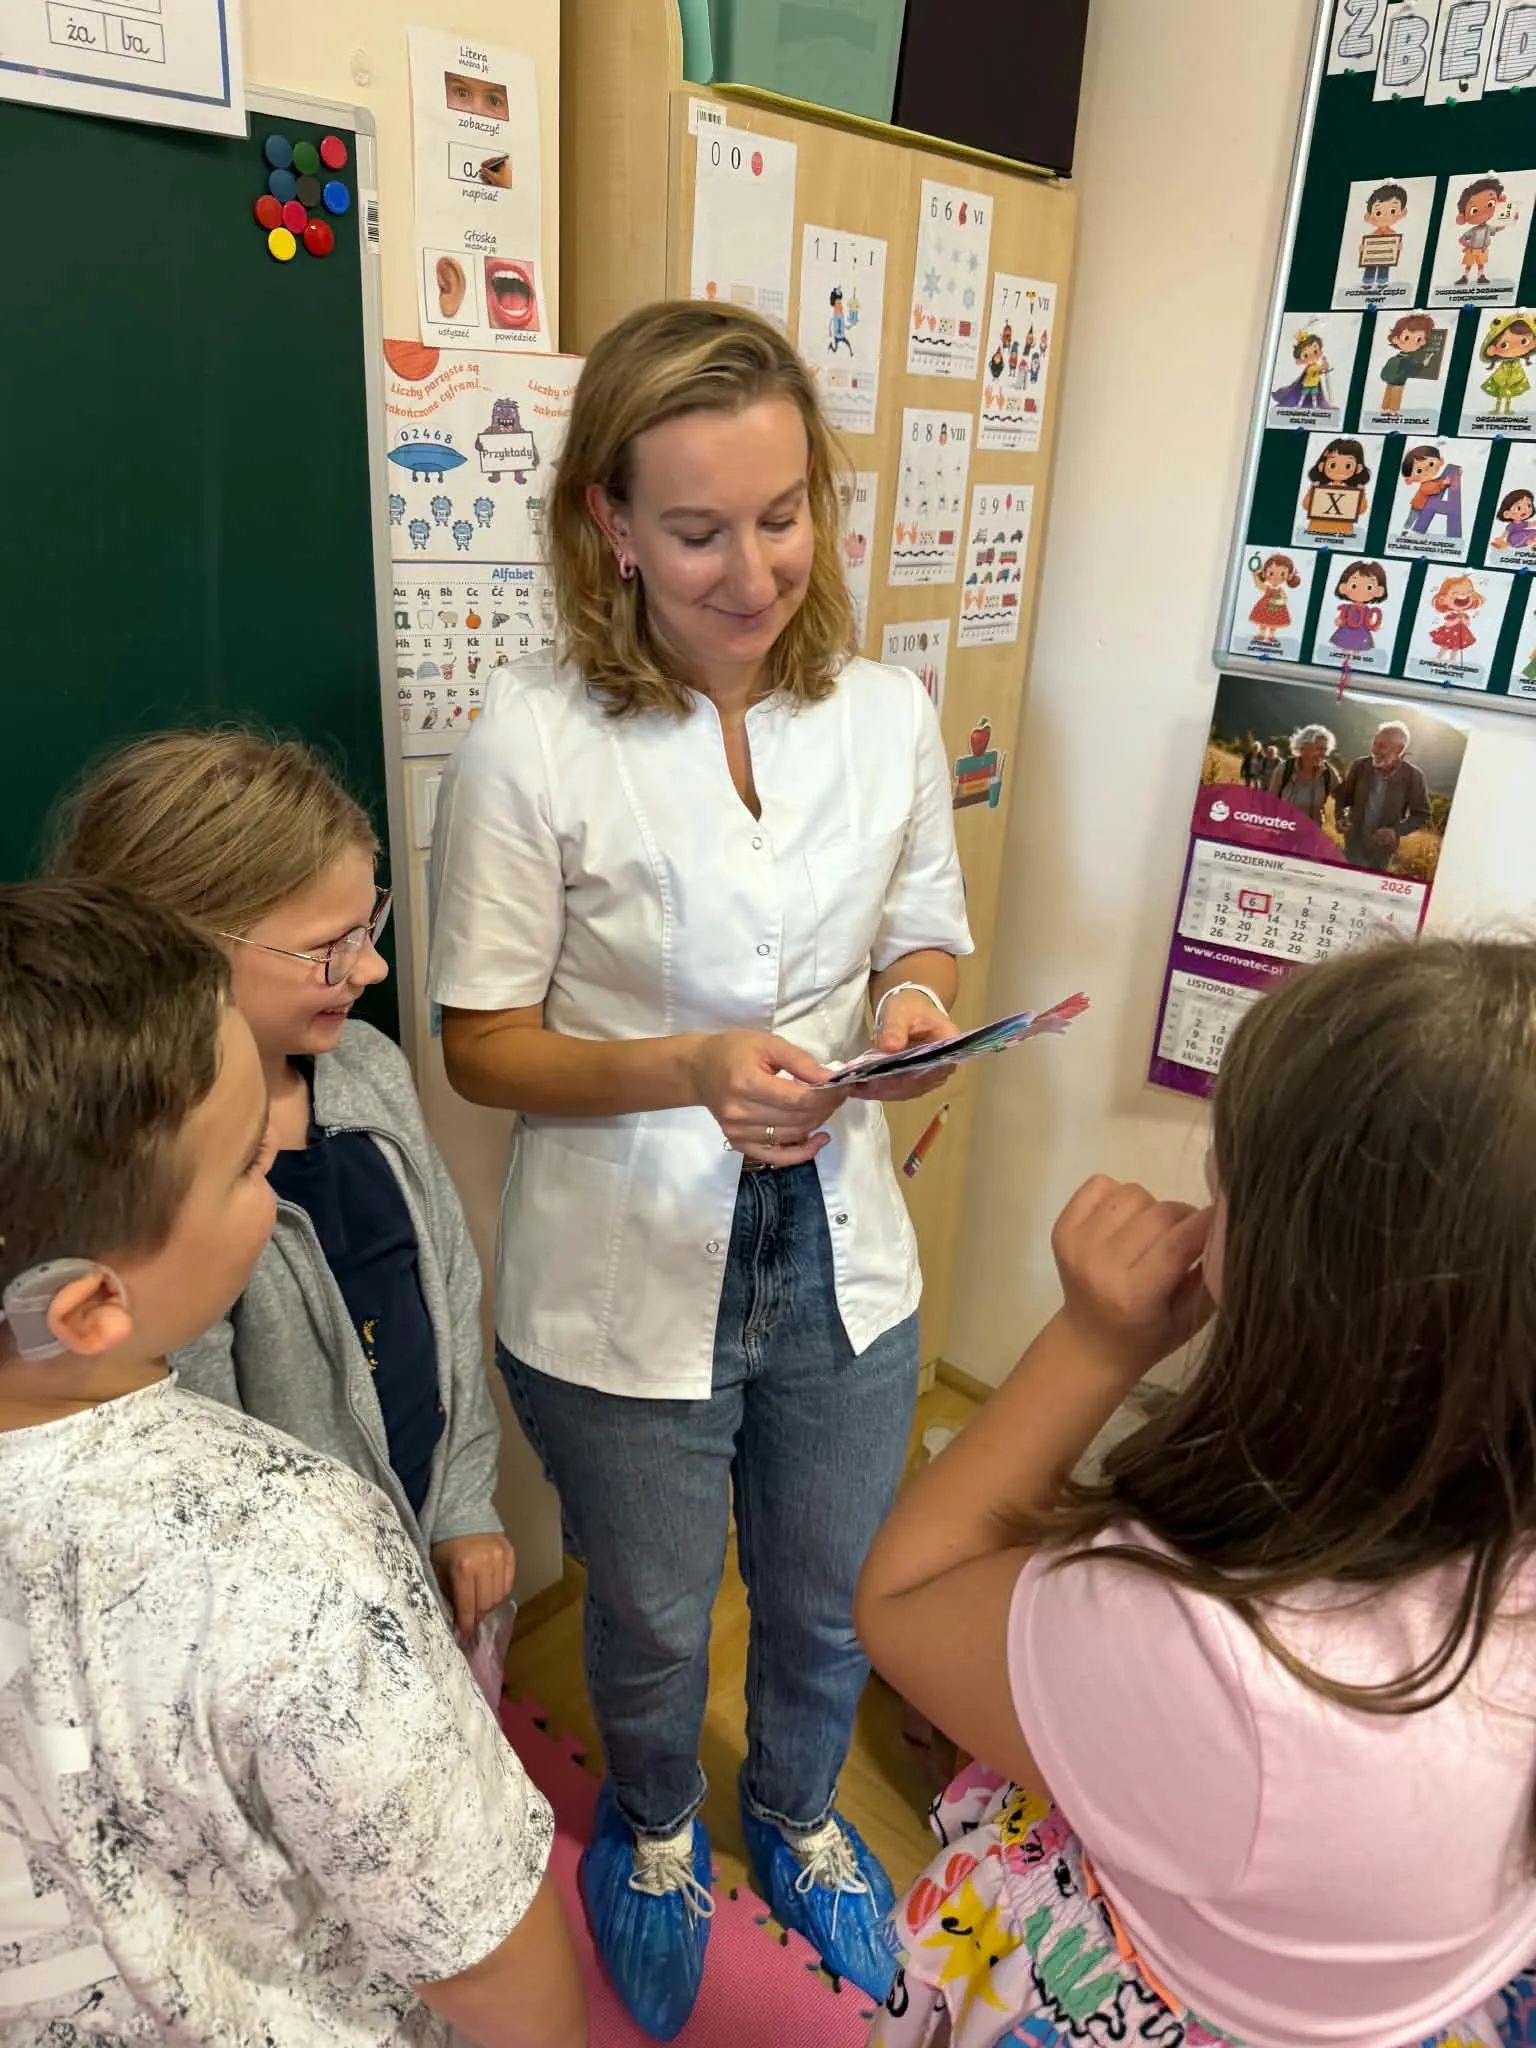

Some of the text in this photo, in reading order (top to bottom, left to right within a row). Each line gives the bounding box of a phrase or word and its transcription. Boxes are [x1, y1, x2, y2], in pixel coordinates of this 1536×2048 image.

[67, 17, 150, 54] ża ba
[460, 46, 488, 62] Litera
[458, 117, 500, 136] zobaczyć
[712, 141, 741, 170] 0 0
[462, 188, 499, 203] napisać
[931, 196, 984, 225] 6 6 VI
[464, 229, 497, 244] Głoska
[832, 241, 838, 263] 1
[1015, 290, 1021, 309] 7
[495, 332, 537, 343] powiedzieć
[391, 382, 423, 400] Liczby
[528, 379, 560, 400] Liczby
[400, 428, 453, 444] 0 2 4 6 8
[912, 422, 919, 442] 8
[926, 423, 933, 442] 8
[482, 446, 533, 461] Przykłady
[992, 497, 999, 515] 9
[1323, 492, 1346, 516] X
[492, 567, 535, 583] Alfabet
[393, 587, 407, 597] Aa
[440, 587, 453, 597] Bb
[466, 587, 479, 597] Cc
[492, 585, 505, 597] Ćć
[515, 587, 529, 597] Dd
[396, 638, 410, 649] Hh
[443, 637, 453, 650] Jj
[467, 637, 480, 647] Kk
[903, 634, 916, 652] 10
[423, 689, 436, 701] Pp
[447, 688, 458, 698] Rr
[469, 687, 480, 697] Ss
[1232, 810, 1297, 832] convatec
[1213, 849, 1286, 871] PAŹDZIERNIK
[1380, 880, 1413, 895] 2026
[1223, 892, 1232, 902] 5
[1248, 897, 1257, 907] 6
[1275, 902, 1283, 913] 7
[1301, 907, 1310, 918] 8
[1329, 913, 1337, 924] 9
[1331, 901, 1340, 911] 2
[1359, 906, 1367, 917] 3
[1215, 903, 1230, 914] 12
[1267, 914, 1281, 925] 14
[1294, 919, 1307, 930] 15
[1320, 924, 1333, 936] 16
[1214, 915, 1227, 926] 19
[1237, 920, 1252, 931] 20
[1264, 926, 1279, 937] 21
[1290, 931, 1305, 943] 22
[1316, 936, 1331, 948] 23
[1209, 927, 1328, 960] 26 27 28 29 30
[1183, 944, 1283, 976] www.convatec.pl
[1187, 977, 1235, 997] LISTOPAD
[1185, 1039, 1197, 1050] 16
[1192, 1029, 1224, 1046] 9 10
[1205, 1057, 1219, 1067] 24
